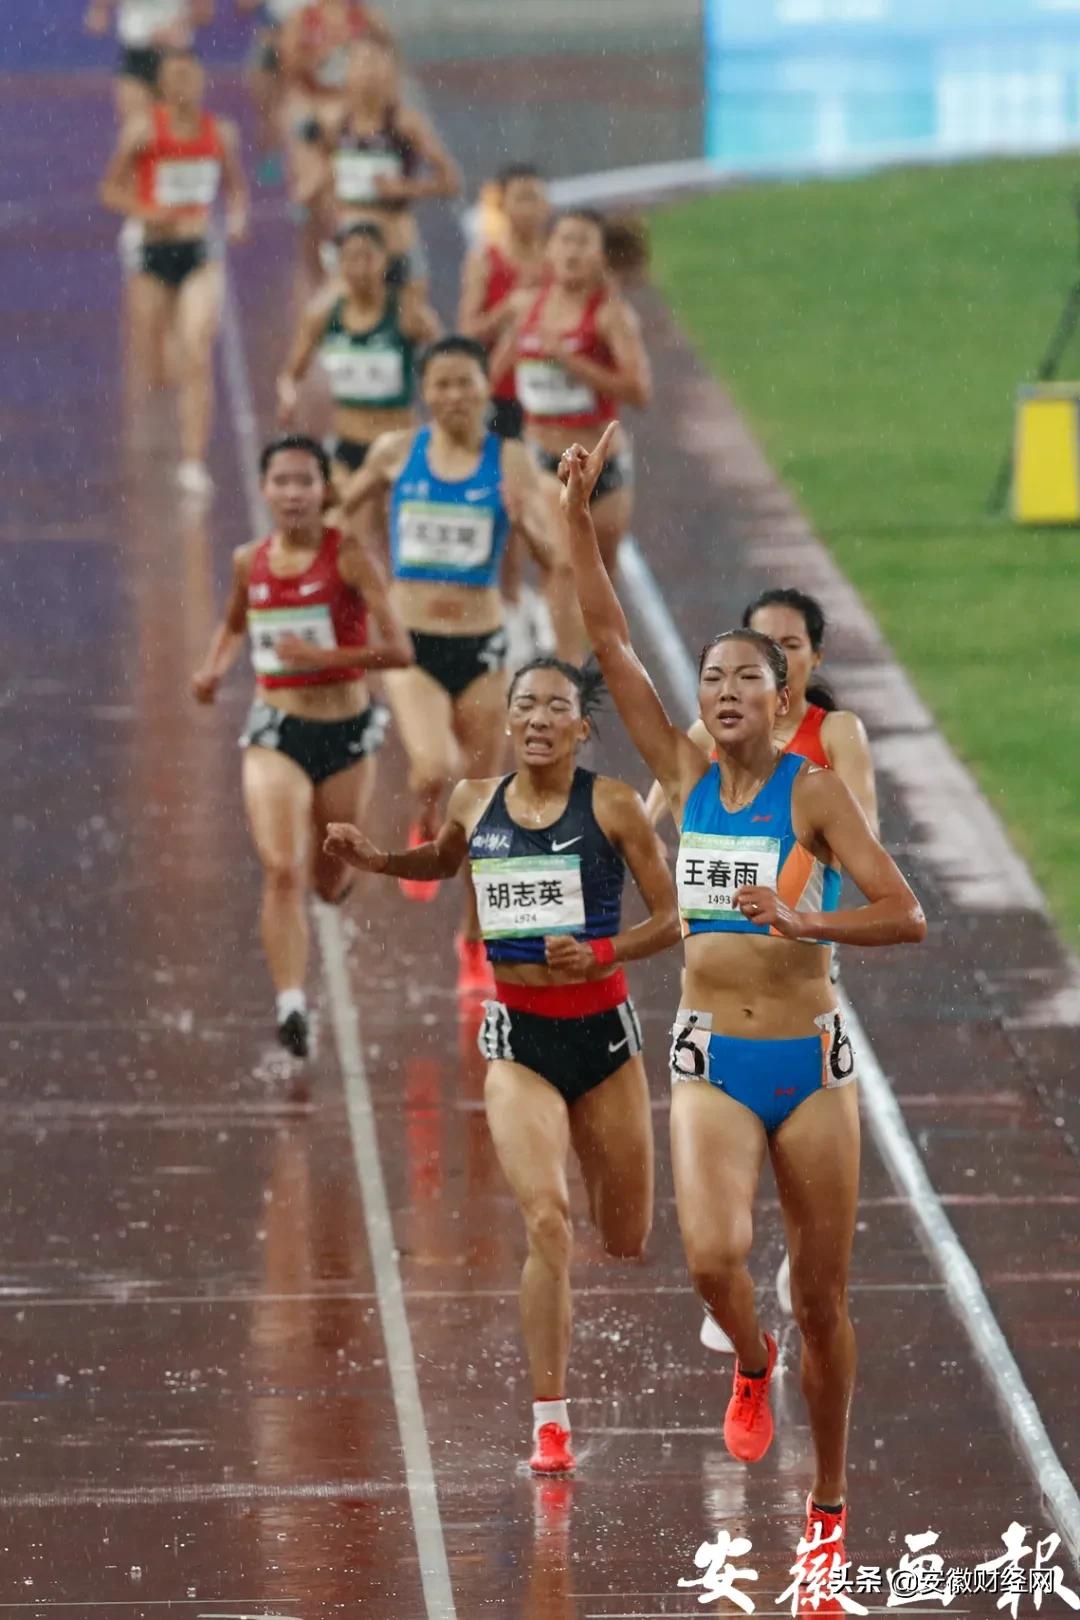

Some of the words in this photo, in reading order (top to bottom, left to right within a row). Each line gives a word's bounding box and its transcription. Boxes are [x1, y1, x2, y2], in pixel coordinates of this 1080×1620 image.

[683, 859, 759, 889] 王春雨
[486, 880, 563, 909] 胡志英
[708, 894, 731, 905] 1493
[673, 1015, 705, 1076] 6
[830, 1013, 855, 1080] 6
